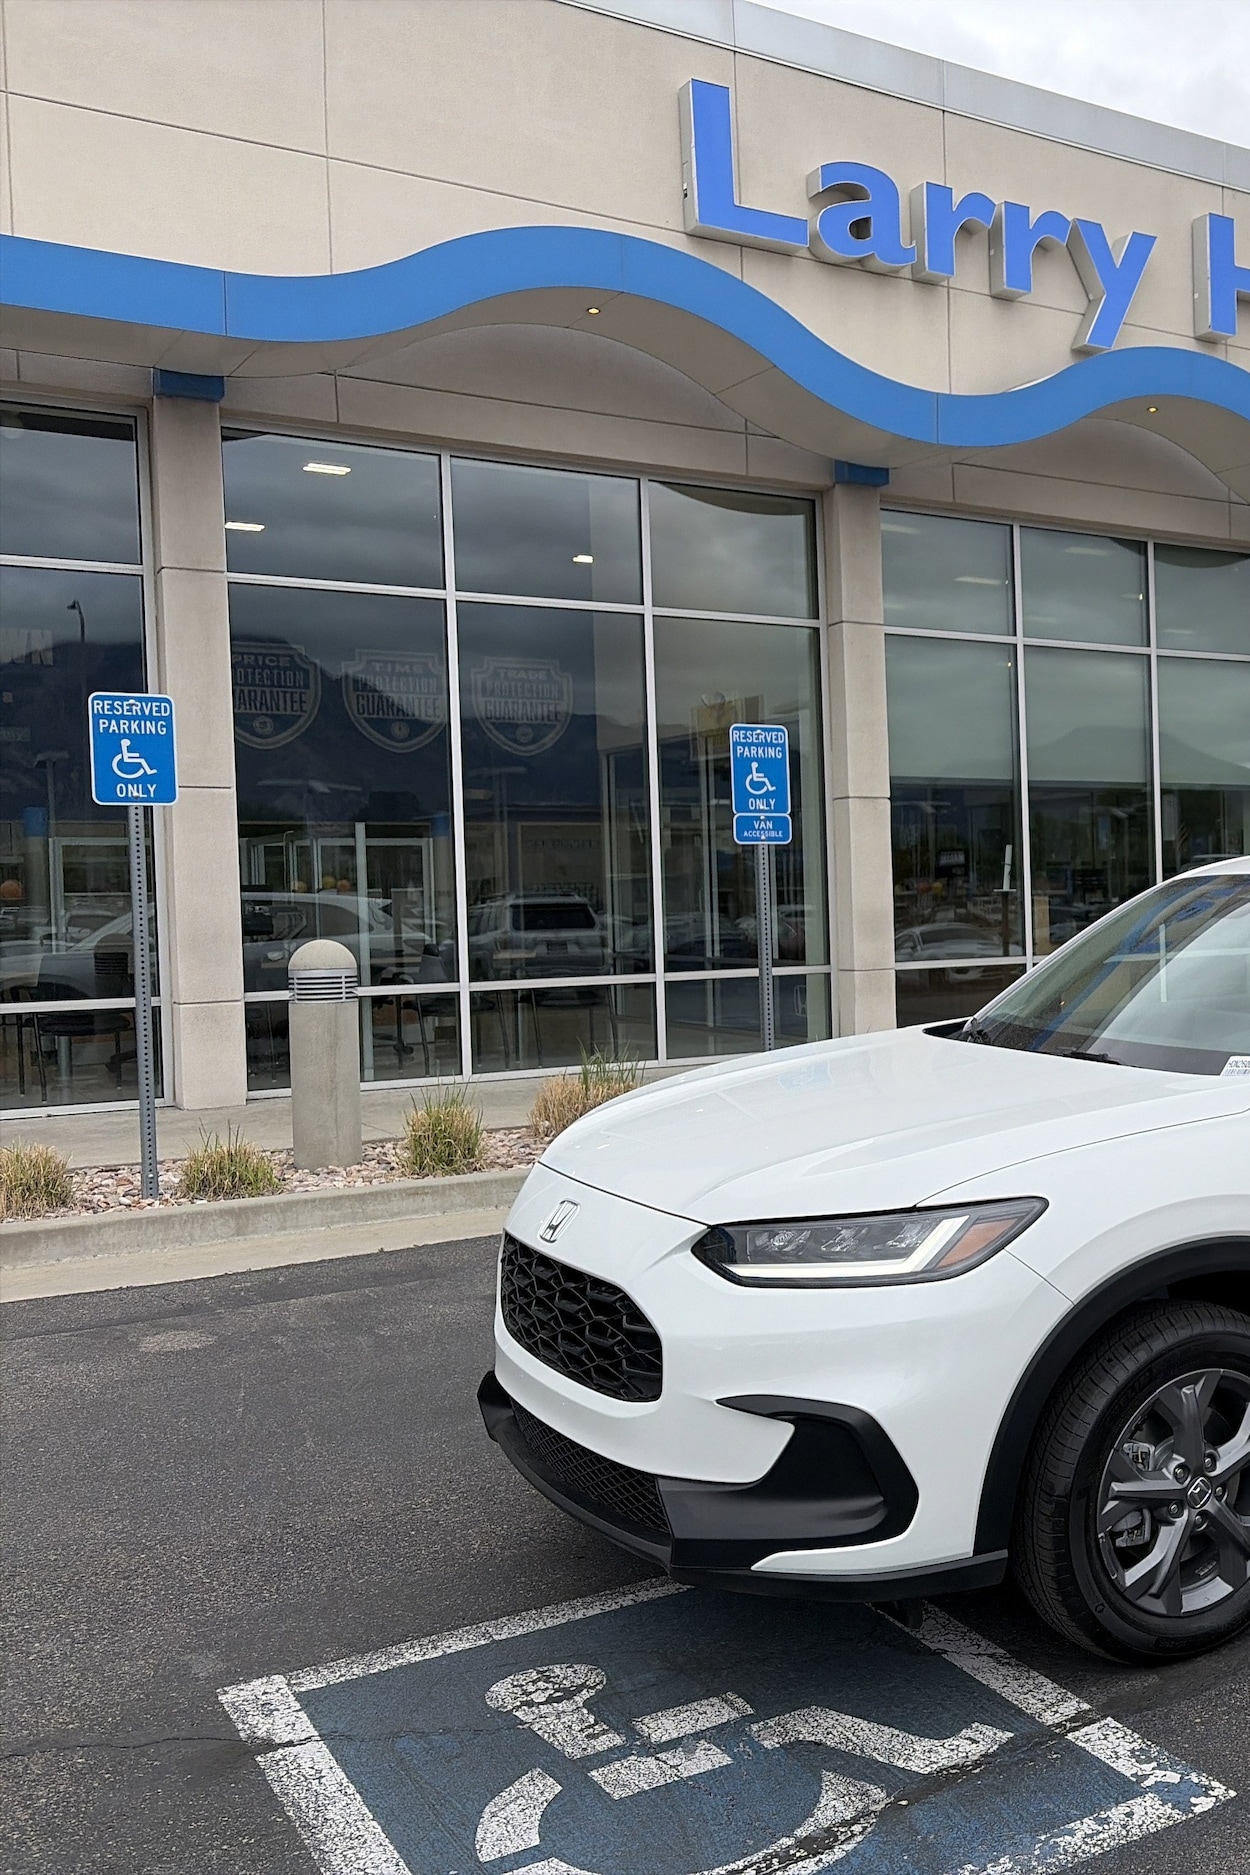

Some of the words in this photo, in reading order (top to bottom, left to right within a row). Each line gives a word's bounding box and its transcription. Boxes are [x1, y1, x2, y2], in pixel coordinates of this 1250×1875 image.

[681, 78, 1156, 353] Larry
[373, 662, 425, 674] TIME
[497, 669, 547, 681] TRADE
[234, 668, 304, 687] OTECTION
[93, 700, 170, 716] RESERVED
[234, 688, 307, 714] ARANTEE
[356, 693, 442, 718] GUARANTEE
[485, 700, 562, 721] GUARANTEE
[99, 719, 167, 735] PARKING
[732, 730, 785, 743] RESERVED
[737, 745, 782, 759] PARKING
[116, 783, 157, 798] ONLY
[748, 798, 776, 810] ONLY
[753, 820, 773, 830] VAN
[743, 830, 783, 838] ACCESSIBLE
